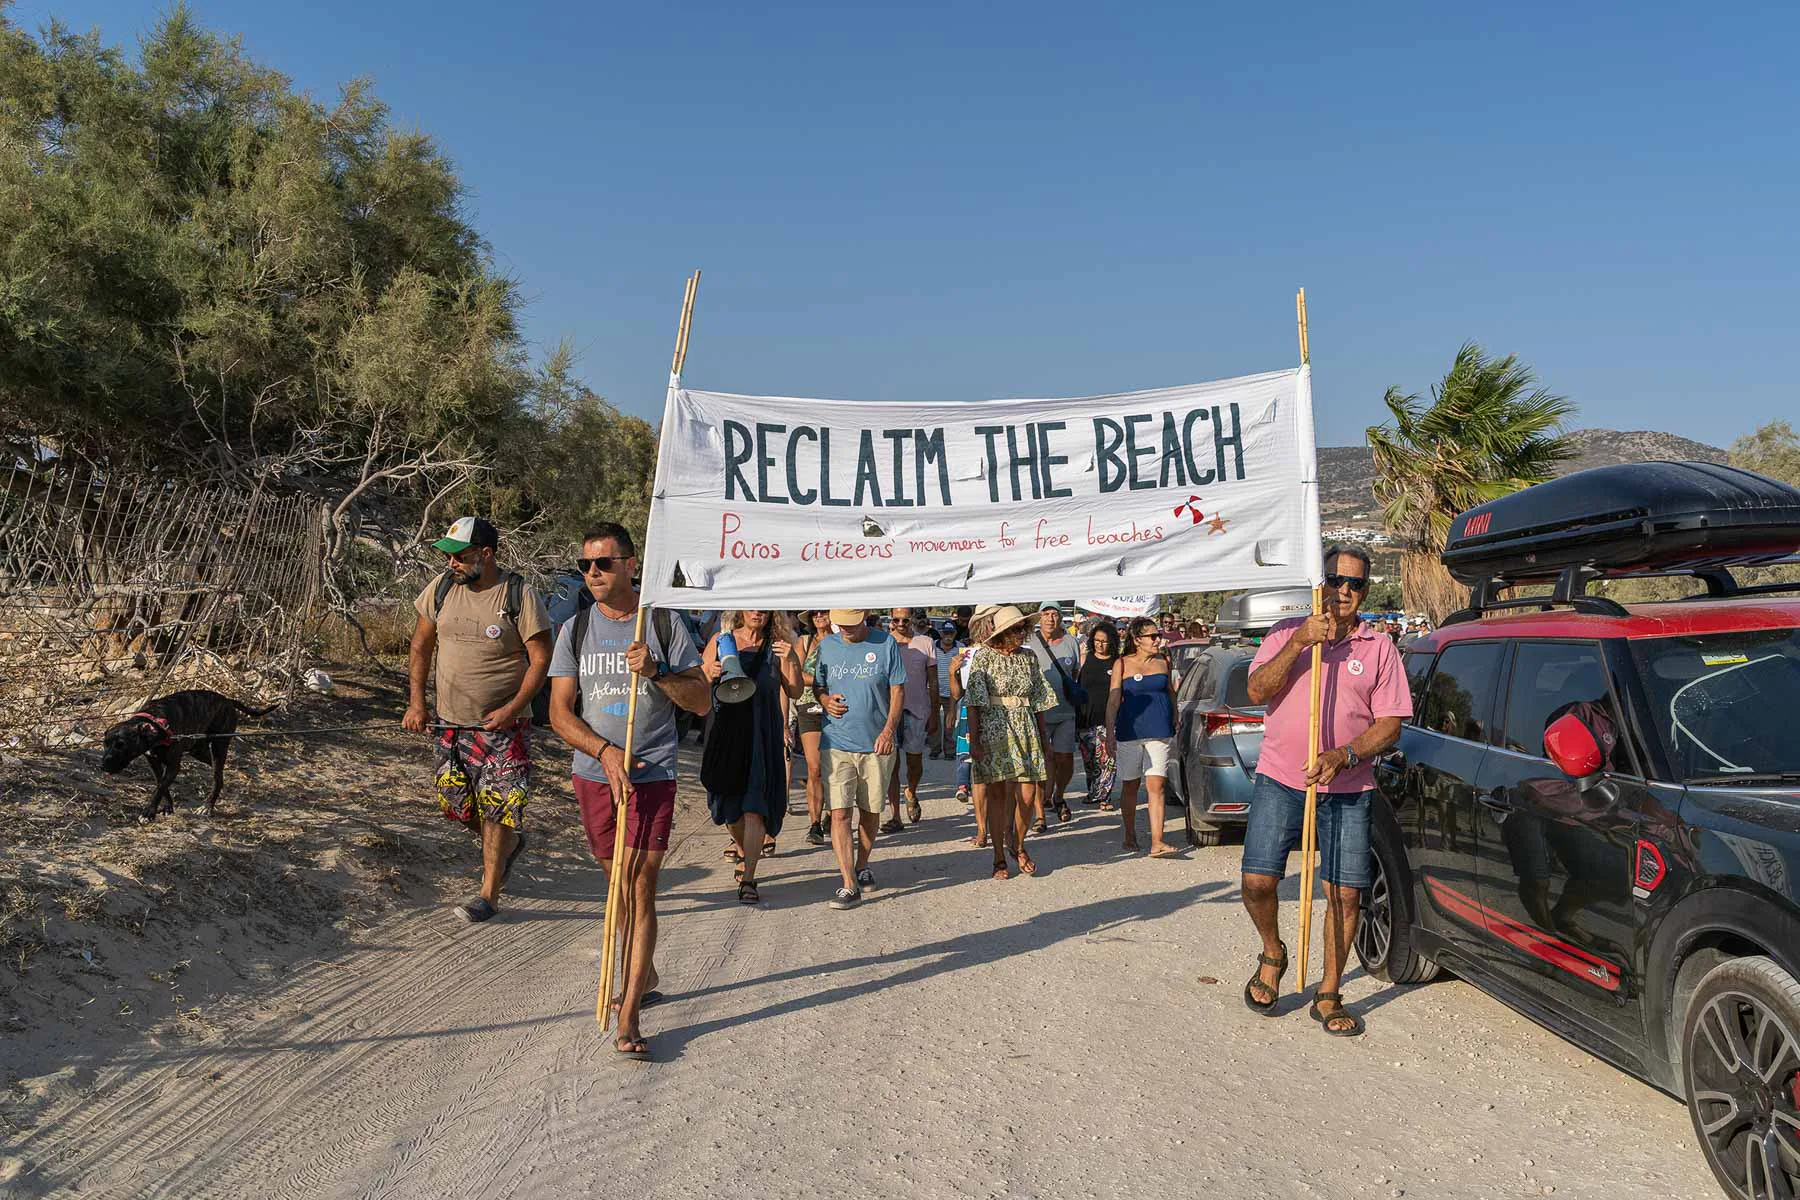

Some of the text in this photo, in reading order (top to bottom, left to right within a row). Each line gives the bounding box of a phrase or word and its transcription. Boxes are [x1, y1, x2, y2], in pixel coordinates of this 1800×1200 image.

[723, 402, 1246, 507] RECLAIM THE BEACH
[719, 511, 781, 560] Paros
[908, 538, 987, 553] movement
[998, 521, 1018, 549] for
[1035, 518, 1073, 549] free
[1087, 514, 1165, 546] beaches
[1463, 511, 1493, 538] MINI
